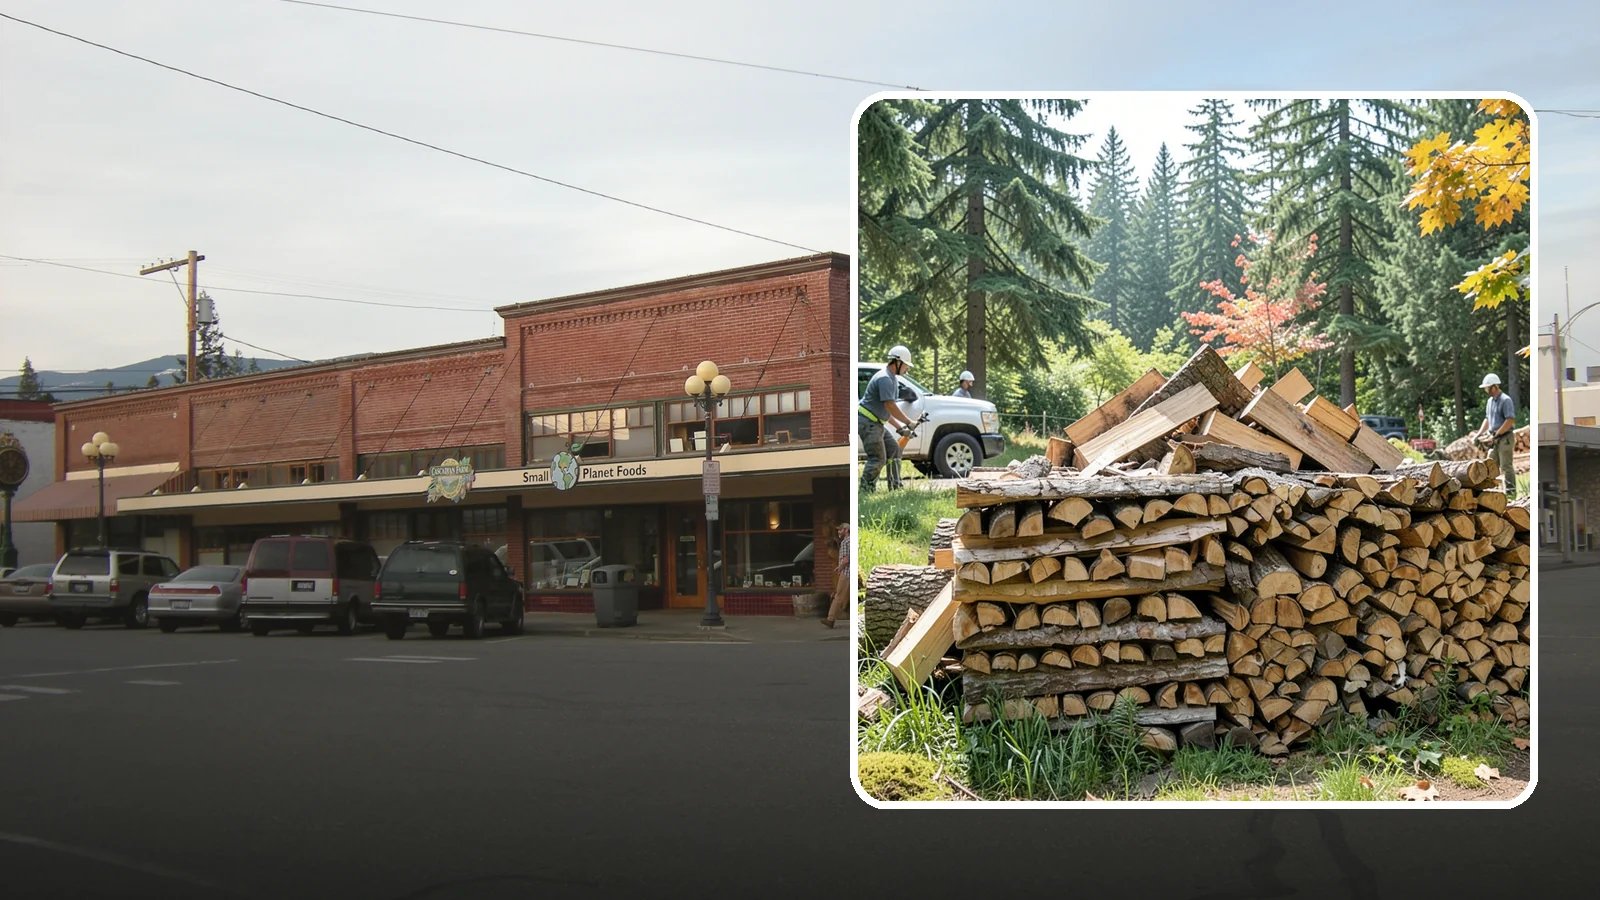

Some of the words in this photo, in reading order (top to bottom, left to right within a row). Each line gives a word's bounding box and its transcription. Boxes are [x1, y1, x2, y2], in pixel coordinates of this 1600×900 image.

[523, 470, 549, 483] Small
[582, 467, 614, 479] Planet
[617, 464, 647, 477] Foods
